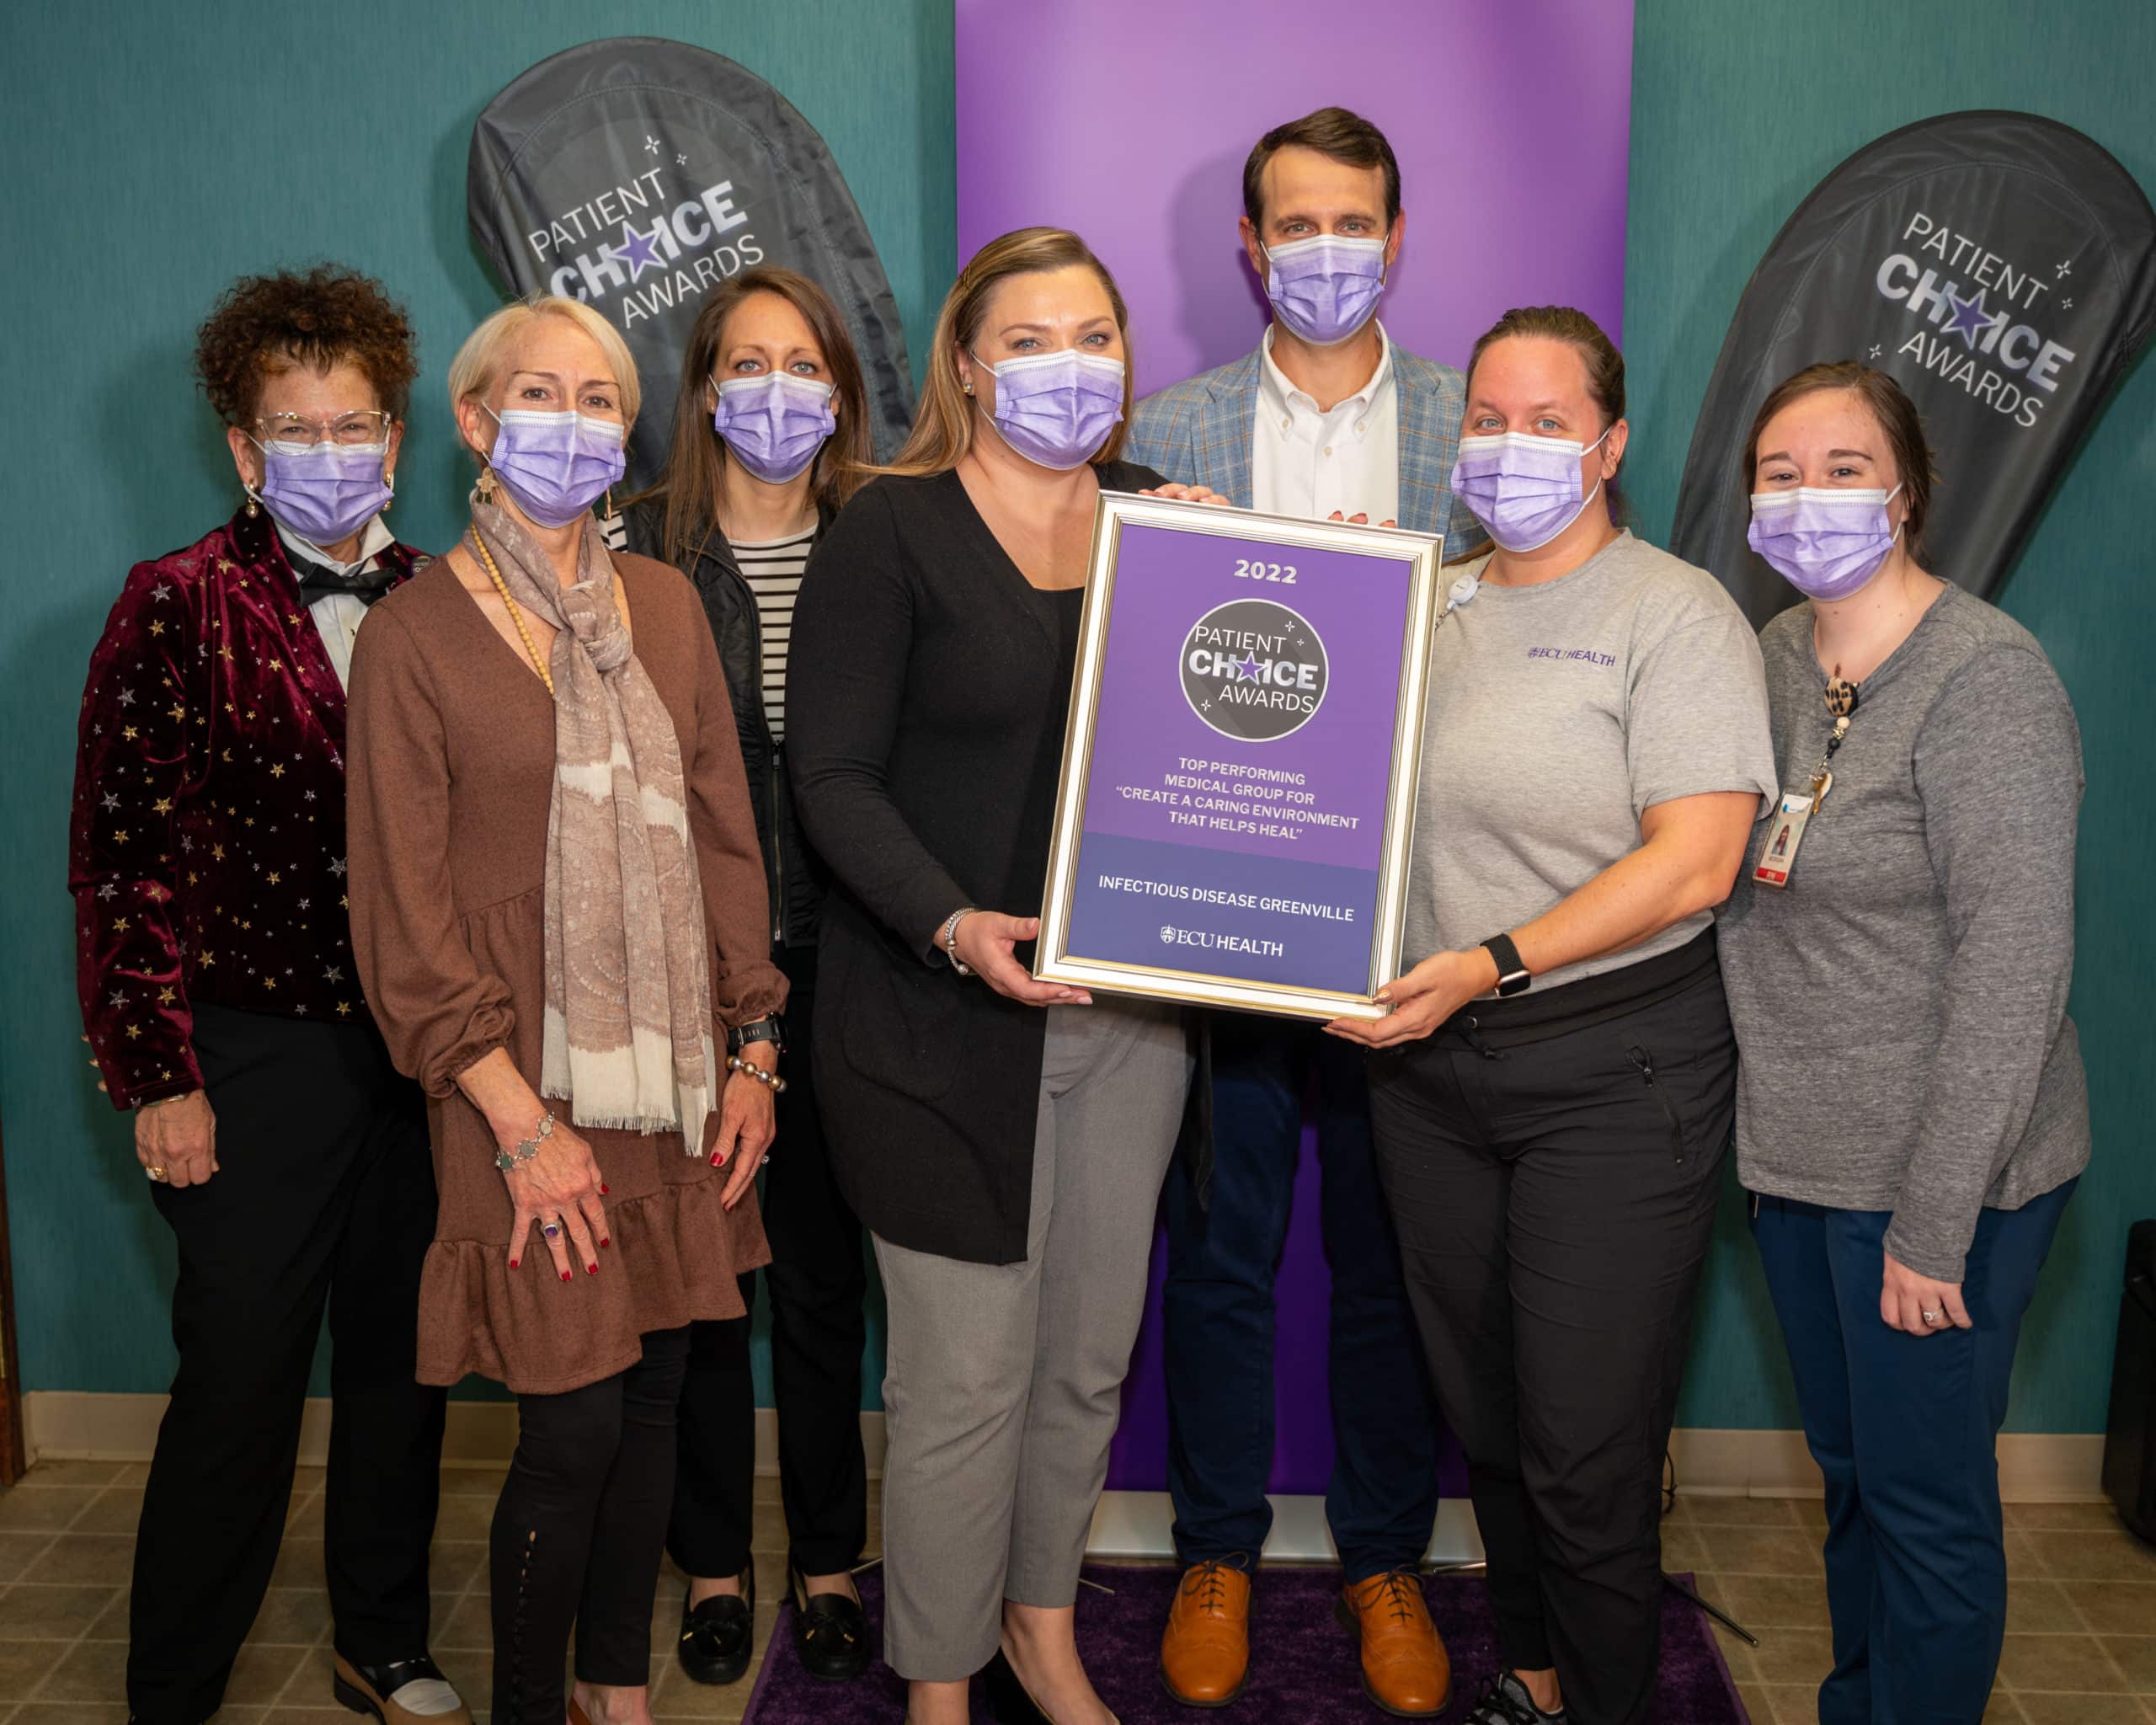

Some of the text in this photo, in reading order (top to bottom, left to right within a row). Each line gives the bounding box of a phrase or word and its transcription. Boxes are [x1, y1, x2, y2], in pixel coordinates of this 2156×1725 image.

[528, 168, 665, 263] PATIENT
[1903, 212, 2048, 309] PATIENT
[622, 234, 764, 328] AWARDS
[1897, 331, 2043, 427] AWARDS
[1234, 559, 1297, 585] 2022
[1194, 626, 1287, 654] PATIENT
[1566, 650, 1615, 666] HEALTH
[1219, 685, 1314, 714] AWARDS
[1179, 757, 1306, 785] TOP PERFORMING
[1165, 774, 1315, 805] MEDICAL GROUP FOR
[1117, 786, 1359, 830] “CREATE A CARING ENVIRONMENT
[1169, 811, 1303, 840] THAT HELPS HEAL”
[1099, 875, 1354, 921] INFECTIOUS DISEASE GREENVILLE
[1177, 929, 1283, 957] ECU HEALTH
